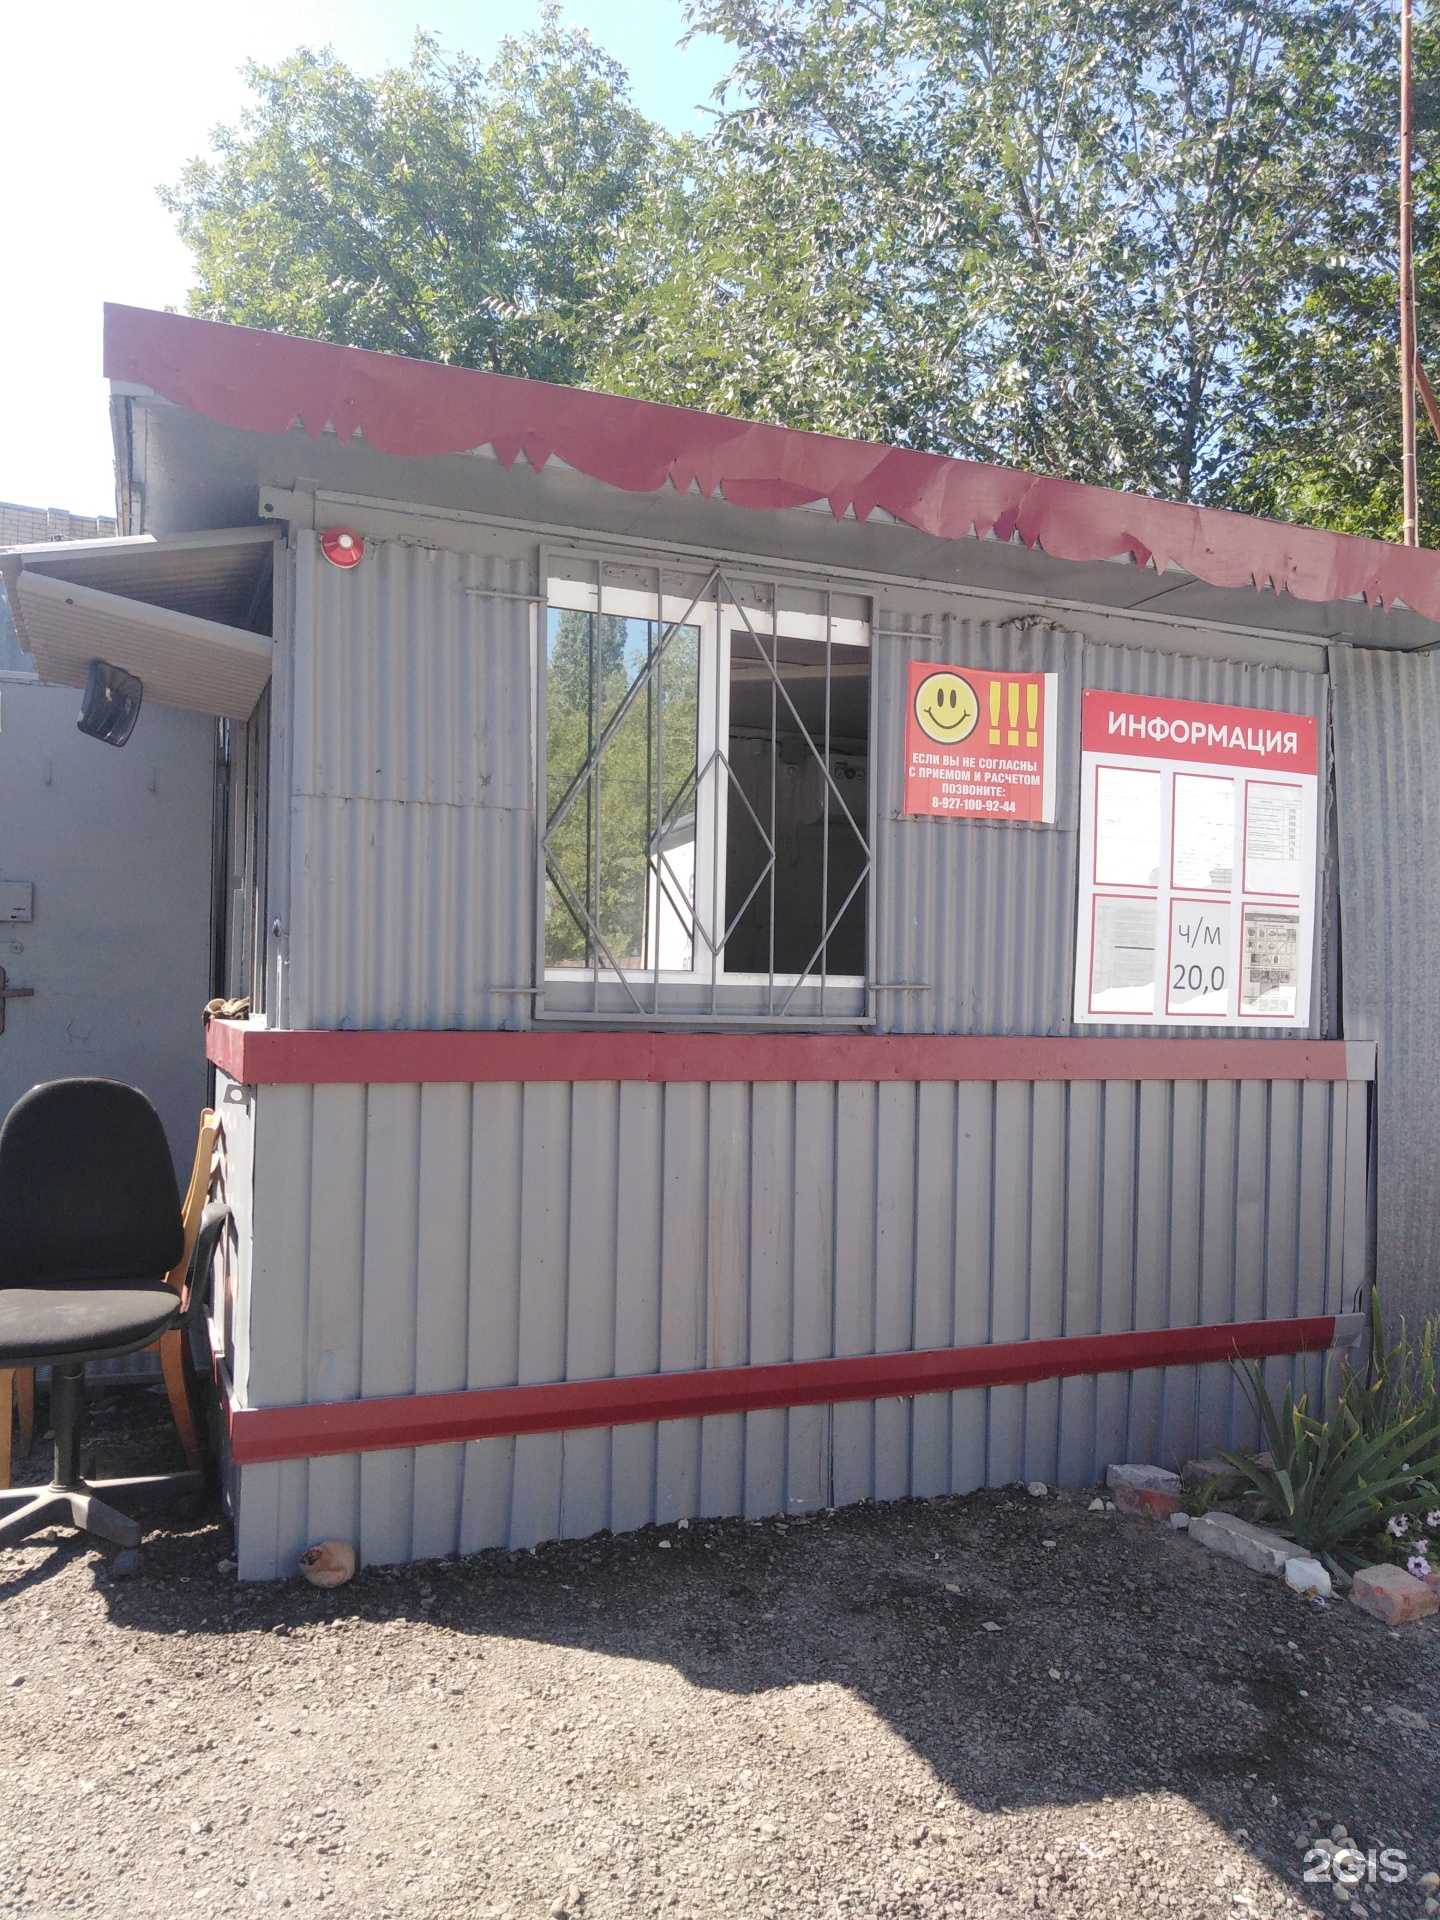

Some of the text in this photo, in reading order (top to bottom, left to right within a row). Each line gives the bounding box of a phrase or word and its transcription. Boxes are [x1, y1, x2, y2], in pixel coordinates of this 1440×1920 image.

[1108, 711, 1298, 755] ИНФОРМАЦИЯ
[912, 753, 1037, 771] ЕСЛИ ВЫ НЕ СОГЛАСНЫ
[909, 767, 1040, 785] С ПРИЕМОМ И РАСЧЕТОМ
[942, 784, 1006, 797] ПОЗВОНИТЕ:
[932, 797, 1016, 813] 8-927-100-92-44
[1173, 964, 1225, 995] 20,0
